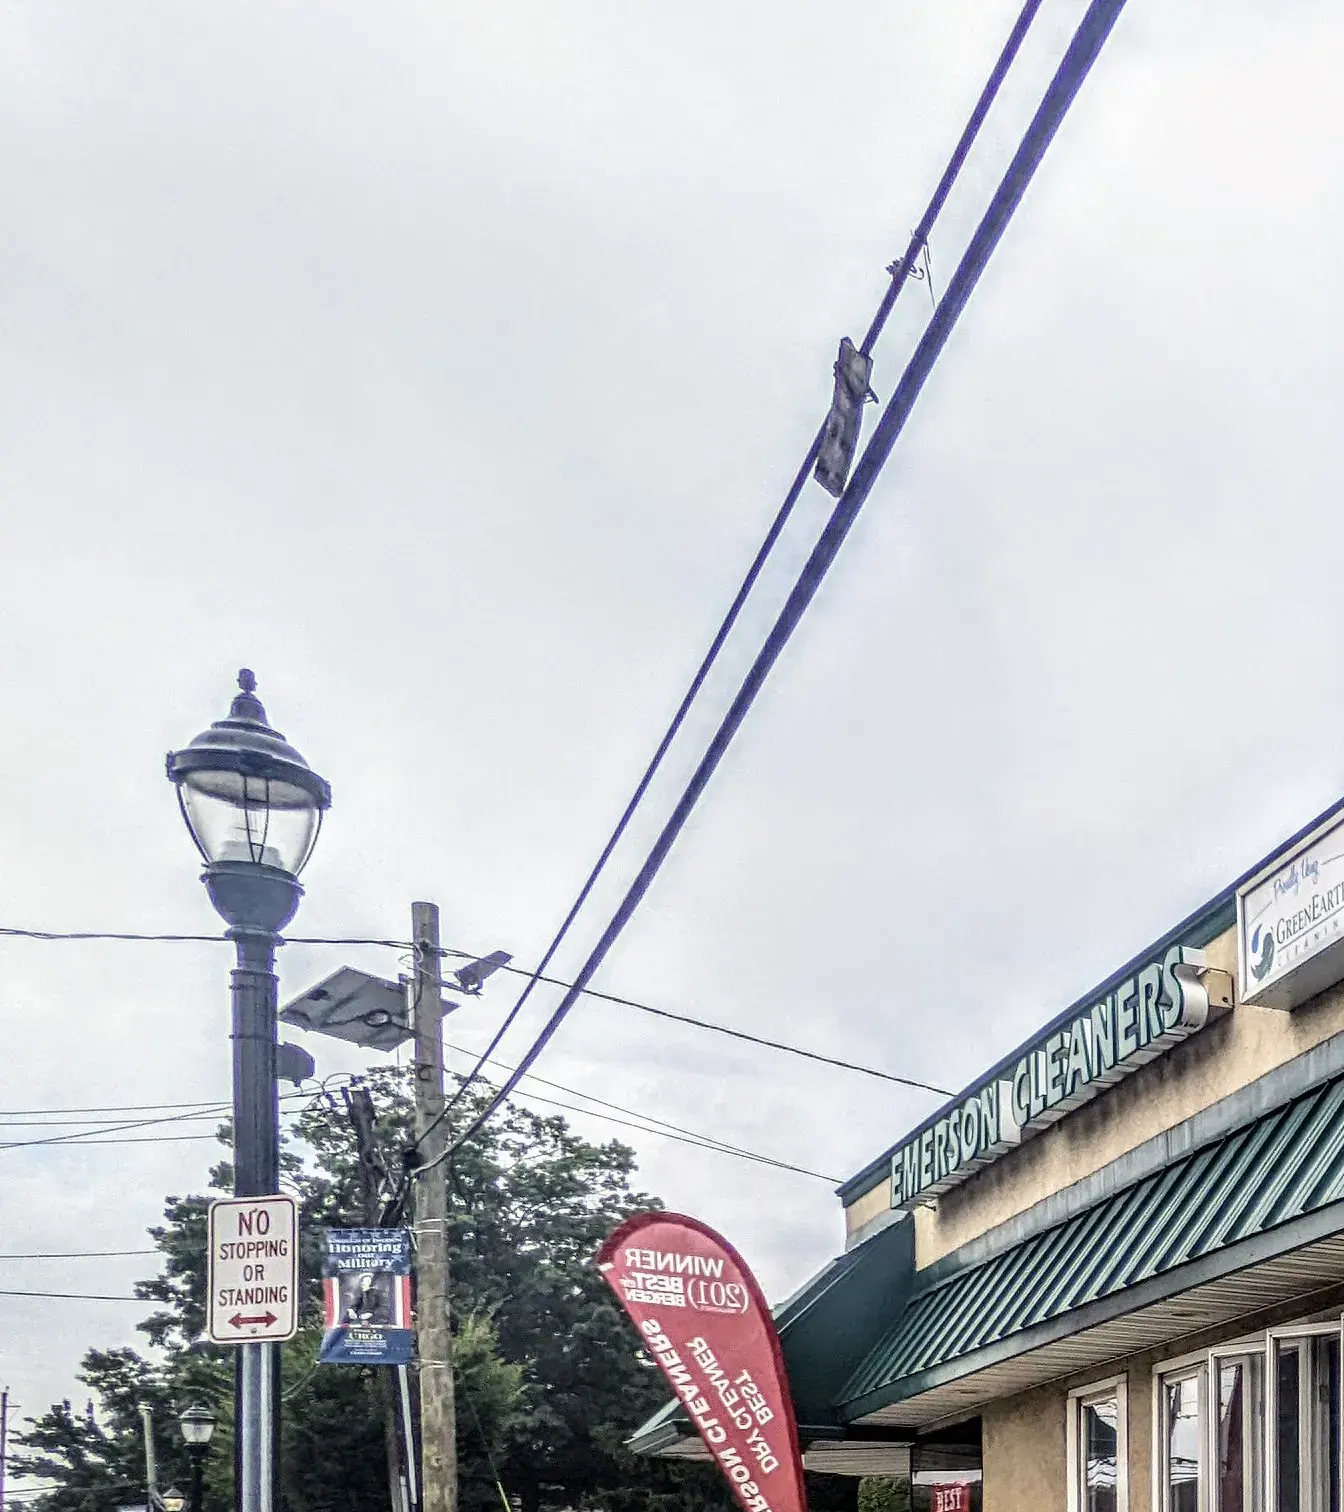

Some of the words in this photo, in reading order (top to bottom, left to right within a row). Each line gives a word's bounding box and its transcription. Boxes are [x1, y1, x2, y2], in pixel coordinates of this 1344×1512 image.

[890, 1079, 1002, 1209] EMERSON
[1011, 944, 1186, 1128] CLEANERS
[238, 1209, 270, 1237] NO
[219, 1239, 288, 1260] STOPPING
[328, 1243, 402, 1254] Honoring
[243, 1264, 265, 1282] OR
[337, 1258, 395, 1269] Military
[218, 1286, 288, 1307] STANDING
[936, 1487, 962, 1512] BEST
